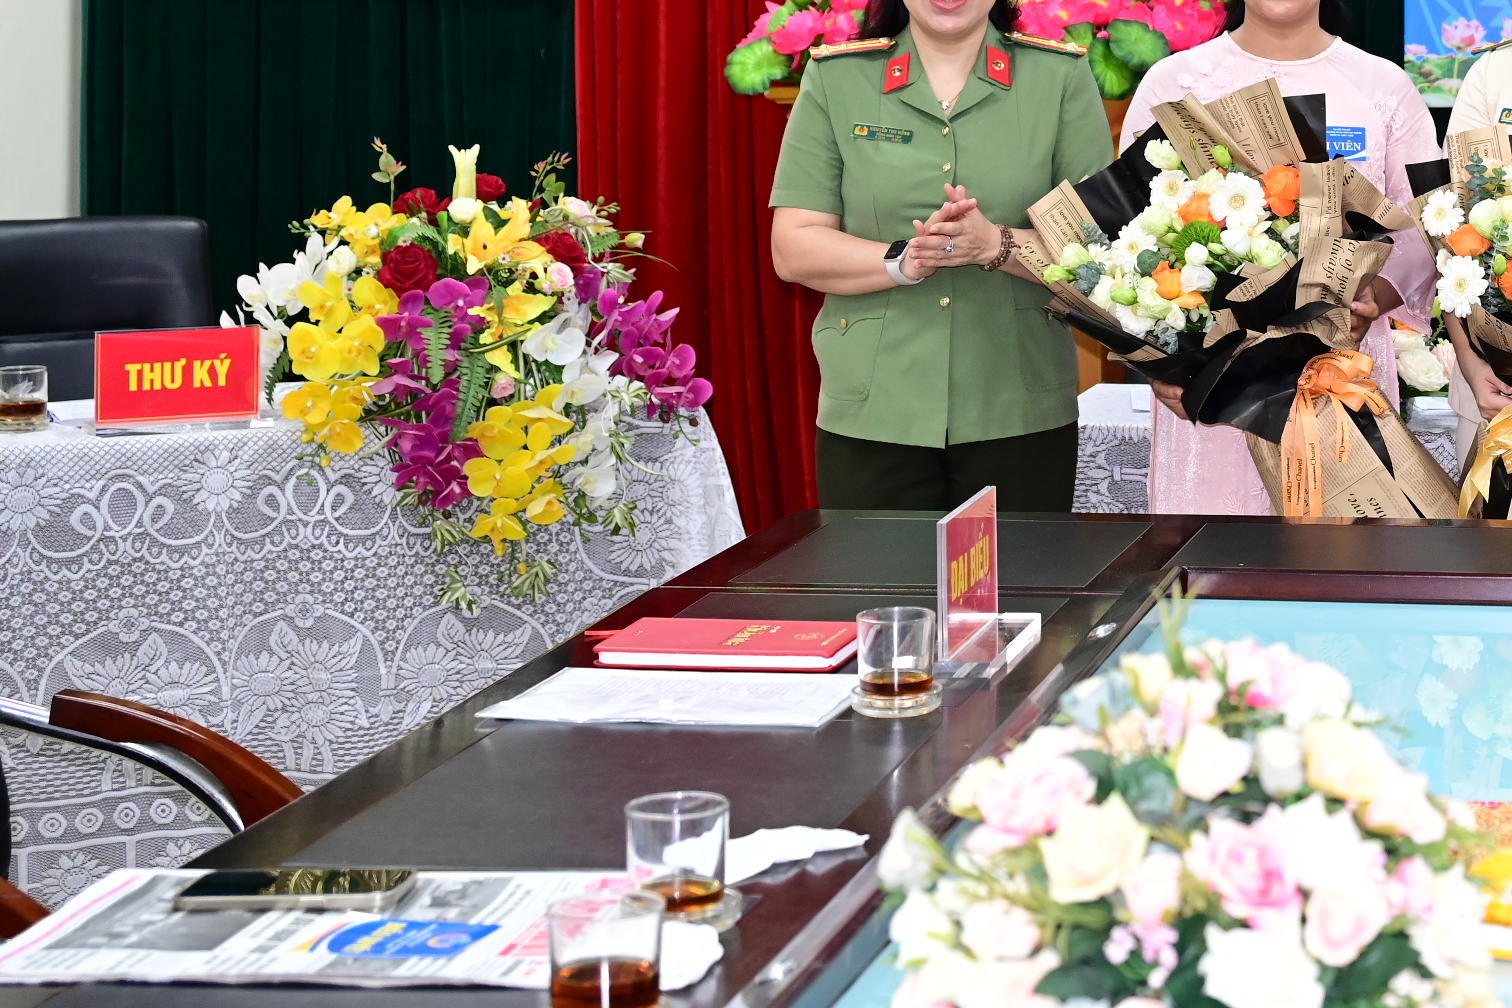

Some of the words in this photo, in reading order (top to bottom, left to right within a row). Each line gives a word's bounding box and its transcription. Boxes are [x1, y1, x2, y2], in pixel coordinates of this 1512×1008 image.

[1333, 139, 1362, 151] VIÊN
[125, 358, 187, 392] THƯ
[193, 353, 232, 388] KÝ
[951, 553, 968, 605] ĐẠI
[970, 521, 990, 587] BIỂU
